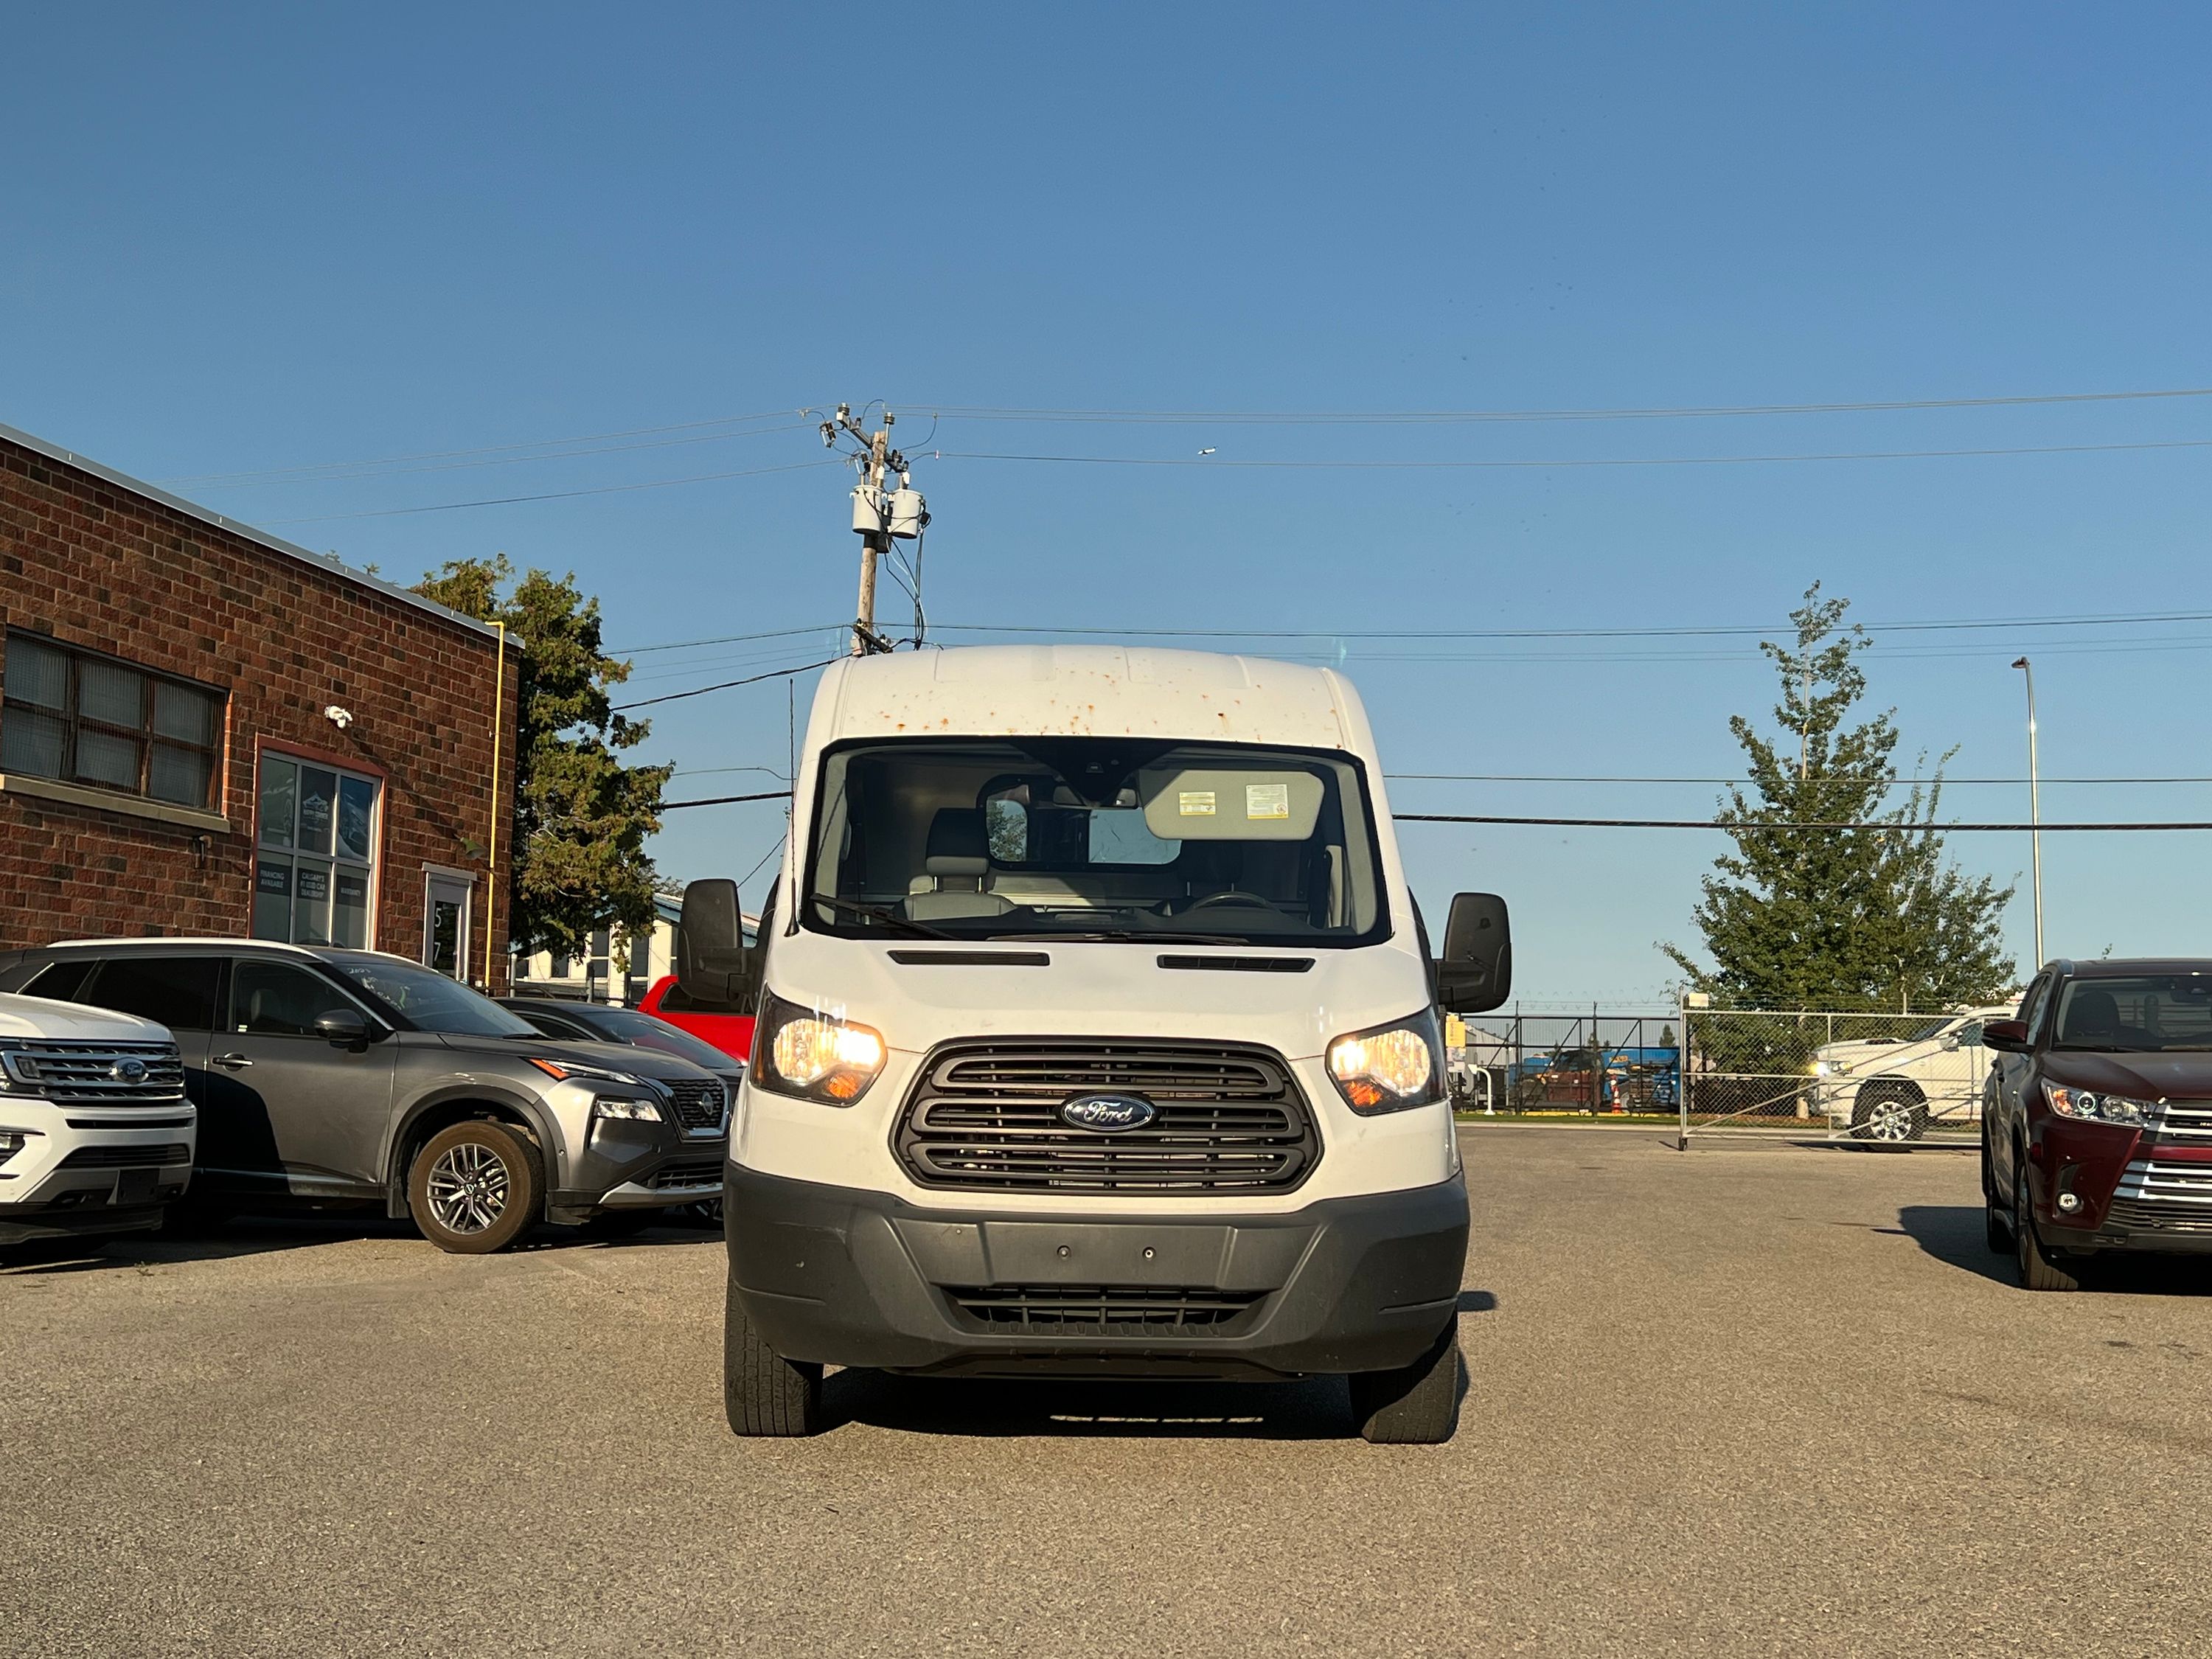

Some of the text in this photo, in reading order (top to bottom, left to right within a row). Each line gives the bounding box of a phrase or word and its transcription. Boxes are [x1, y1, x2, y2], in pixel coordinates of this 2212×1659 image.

[434, 908, 442, 928] 5
[434, 942, 441, 961] 7
[127, 1063, 142, 1075] Ford
[1083, 1101, 1133, 1122] Ford
